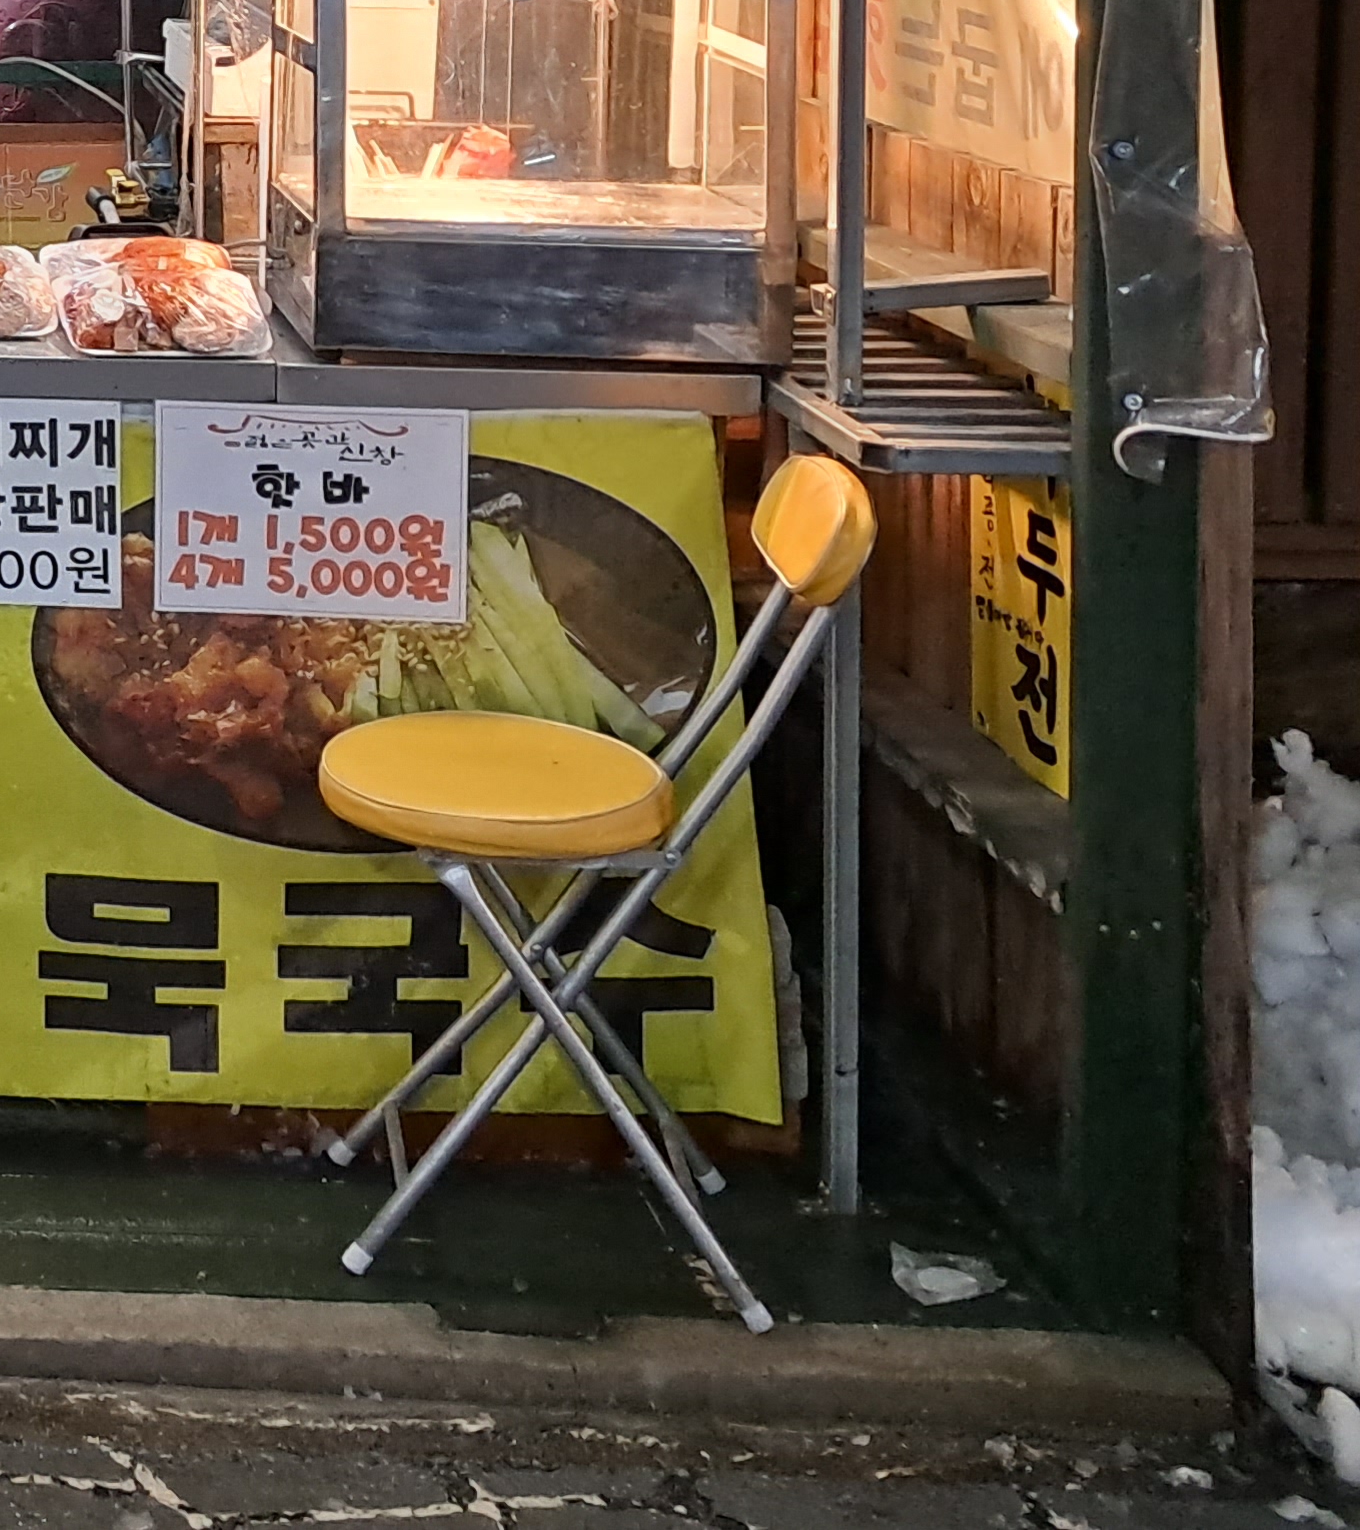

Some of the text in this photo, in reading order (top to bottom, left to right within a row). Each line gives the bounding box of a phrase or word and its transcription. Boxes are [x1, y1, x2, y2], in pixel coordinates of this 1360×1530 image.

[178, 510, 445, 558] 1개 1,500원
[168, 554, 451, 602] 4개 5,000원
